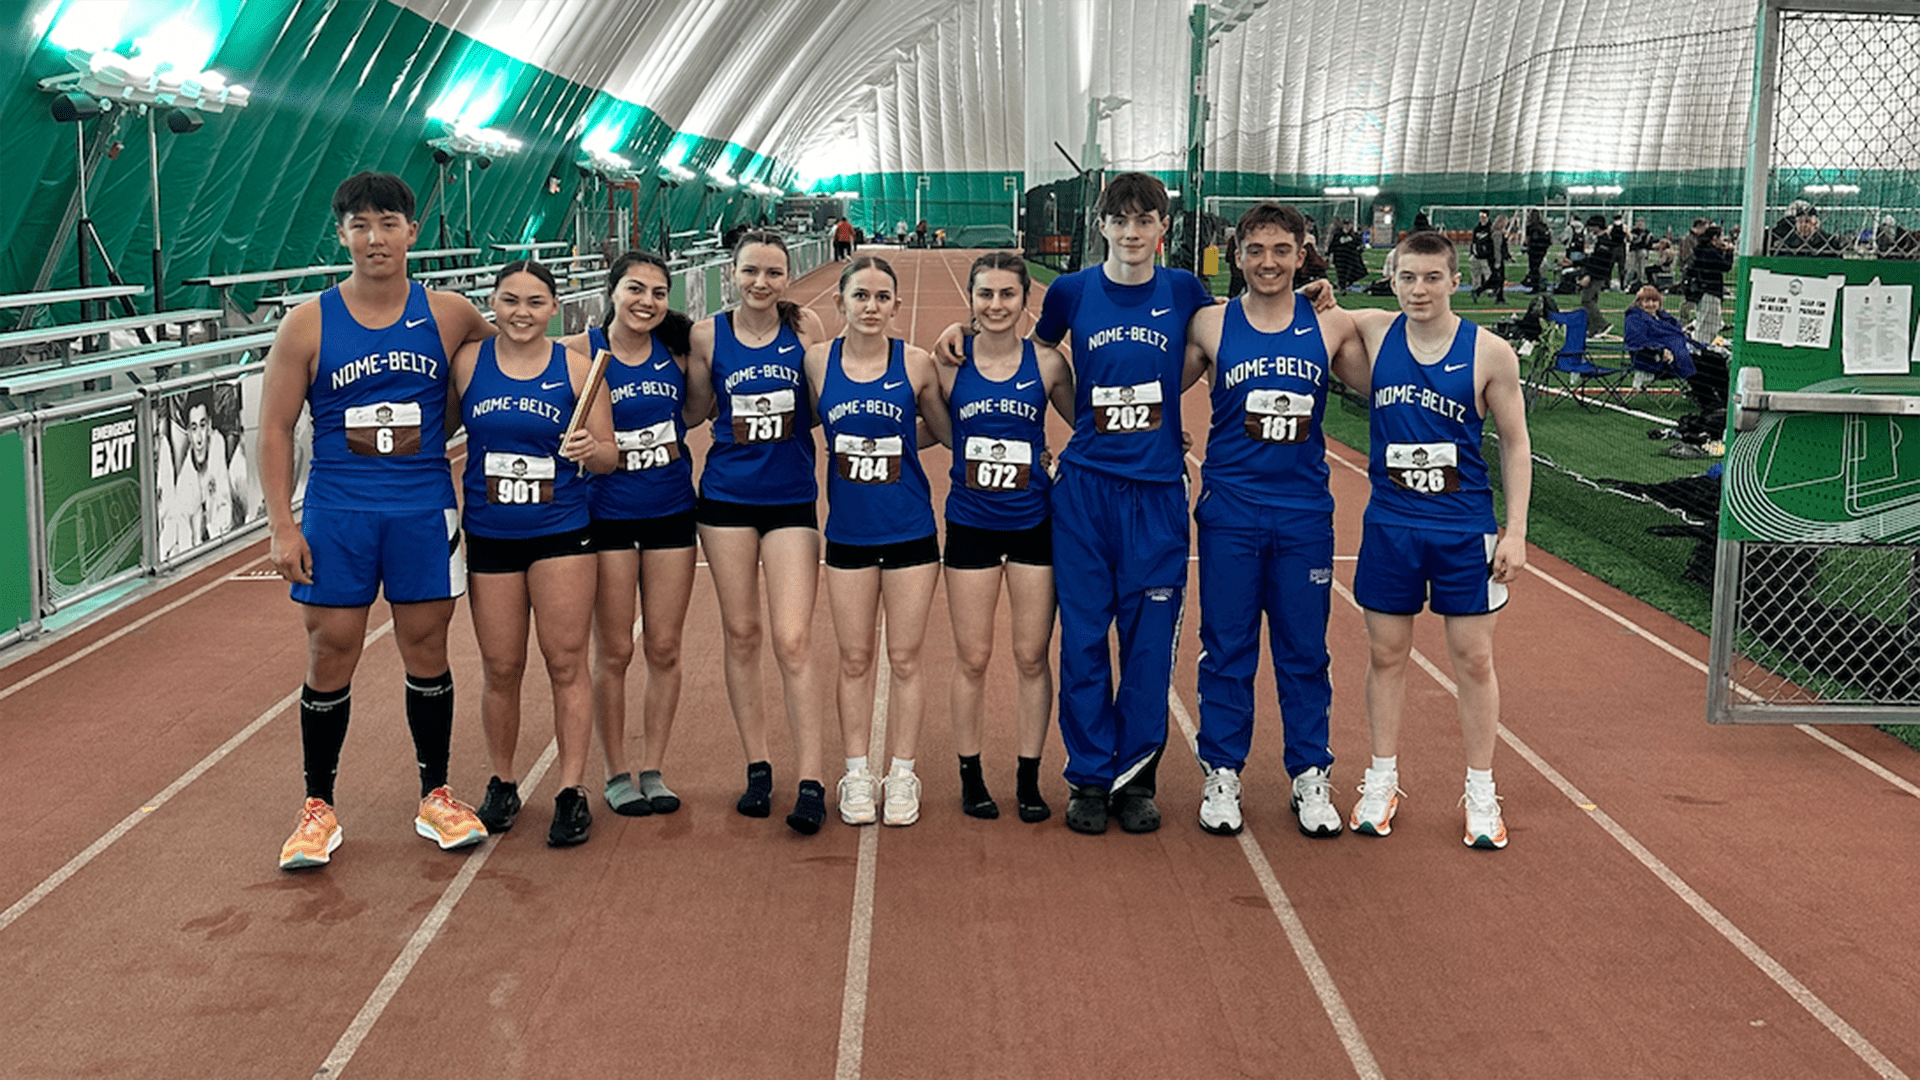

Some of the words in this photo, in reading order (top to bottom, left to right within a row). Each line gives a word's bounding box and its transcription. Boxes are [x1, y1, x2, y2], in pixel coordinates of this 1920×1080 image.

[1088, 325, 1169, 352] NOME-BELTZ
[331, 350, 439, 390] NOME-BELTZ
[724, 363, 800, 394] NOME-BELTZ
[1225, 356, 1323, 389] NOME-BELTZ
[611, 381, 679, 404] OME-BELTZ
[1374, 383, 1468, 424] NOME-BELTZ
[471, 395, 562, 424] NOME-BELTZ
[827, 399, 904, 425] NOME-BELTZ
[959, 397, 1039, 422] NOME-BELTZ
[1105, 405, 1150, 430] 202
[91, 418, 136, 442] EMERGENCY
[376, 427, 395, 454] 6
[745, 415, 783, 441] 737
[1260, 415, 1298, 441] 181
[91, 433, 136, 479] EXIT
[626, 445, 670, 471] 829
[847, 455, 889, 482] 784
[977, 461, 1018, 489] 672
[1401, 467, 1446, 493] 126
[497, 478, 541, 504] 901
